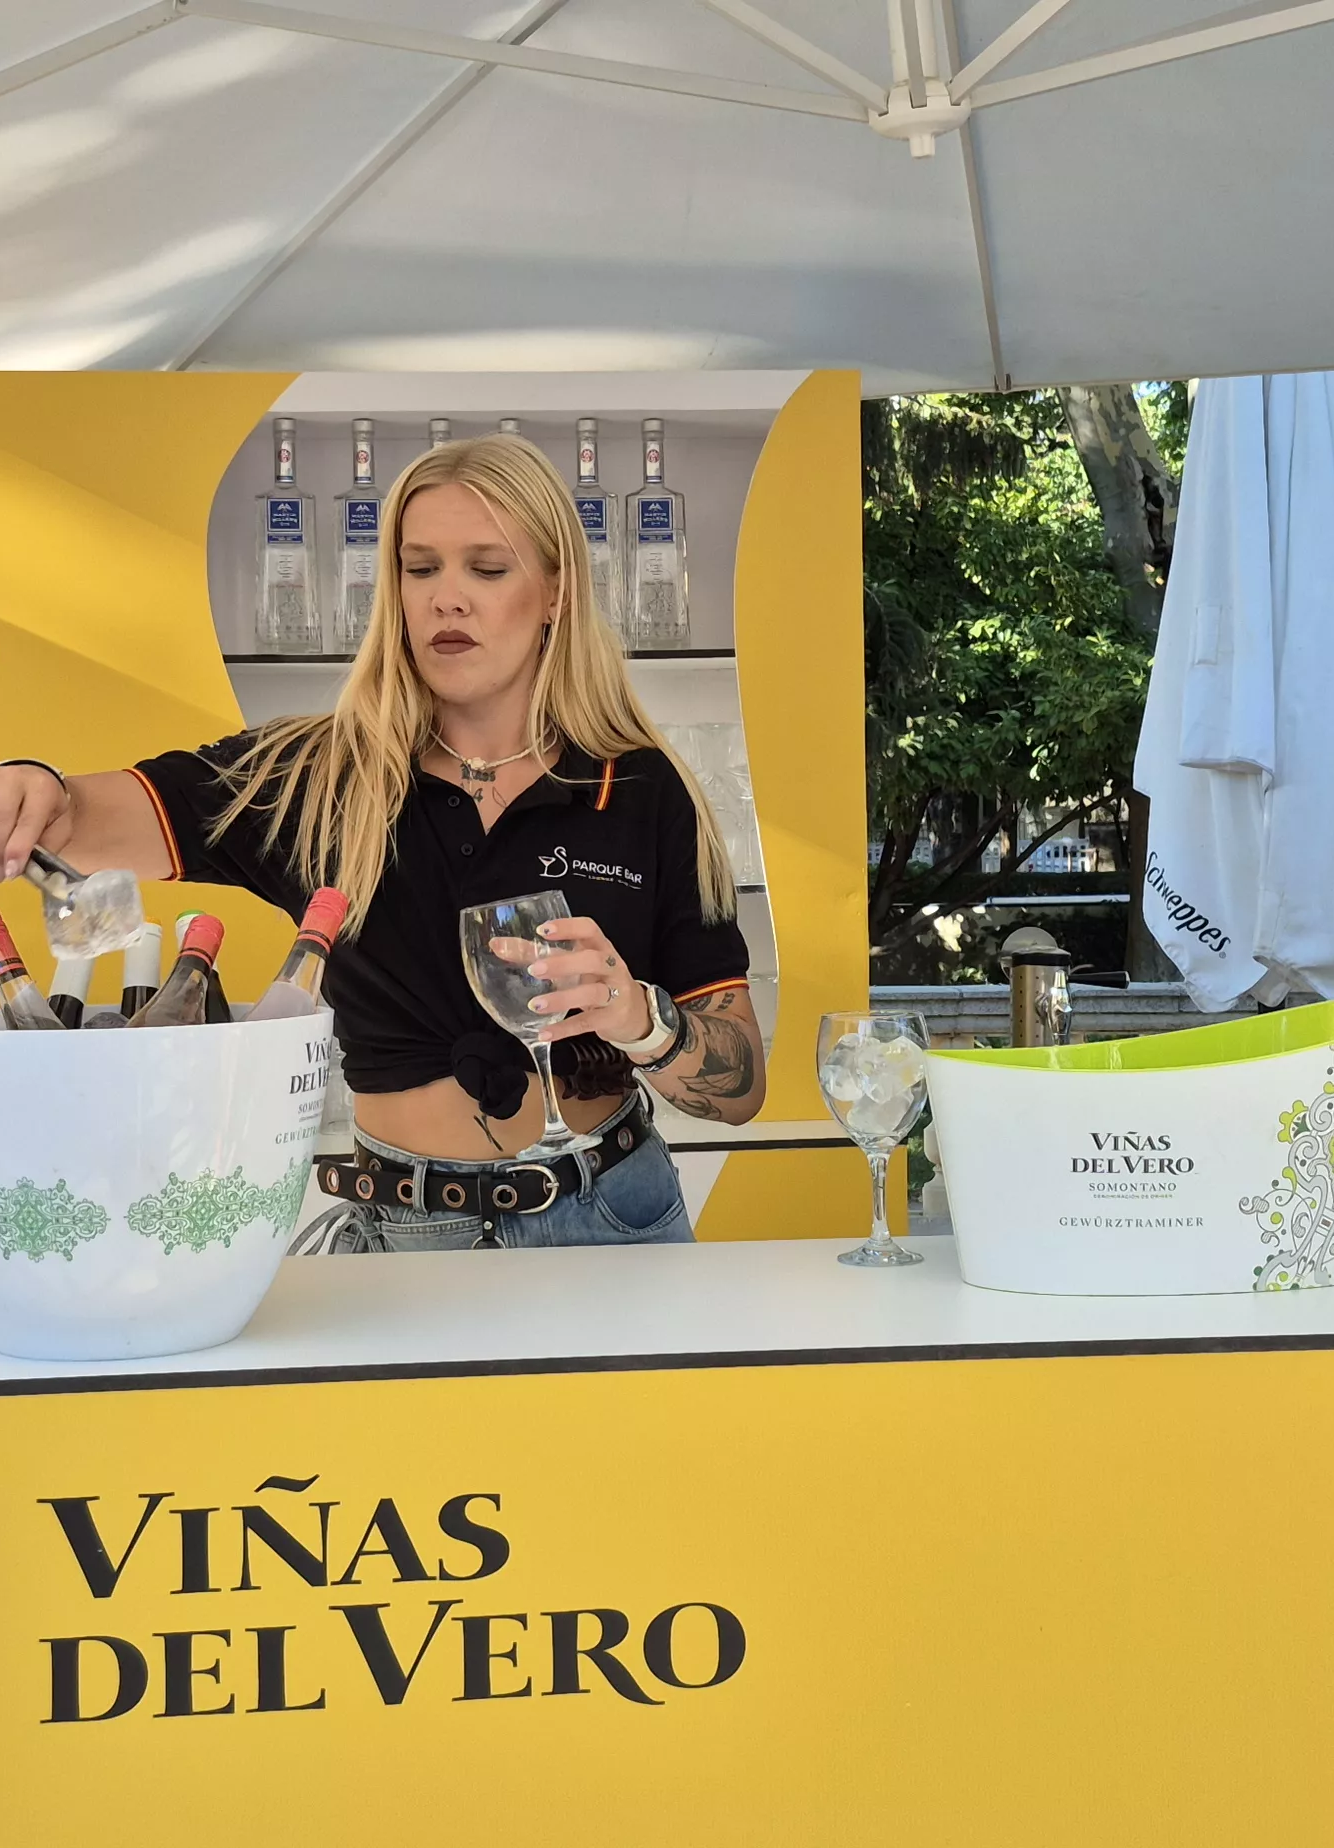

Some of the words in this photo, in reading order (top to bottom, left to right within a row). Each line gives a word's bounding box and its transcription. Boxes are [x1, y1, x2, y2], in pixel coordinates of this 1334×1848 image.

[572, 859, 623, 877] PARQUE
[624, 868, 643, 884] BAR
[1146, 851, 1232, 952] Schweppes
[289, 1071, 316, 1094] DEL
[1089, 1131, 1172, 1151] VIÑAS
[1070, 1157, 1120, 1174] DEL
[1120, 1155, 1195, 1175] VERO
[1089, 1182, 1177, 1192] SOMONTANO
[1059, 1216, 1204, 1228] GEWÜRZTRAMINER
[35, 1474, 511, 1599] VIÑAS
[39, 1625, 326, 1724] DEL
[329, 1598, 747, 1706] VERO
